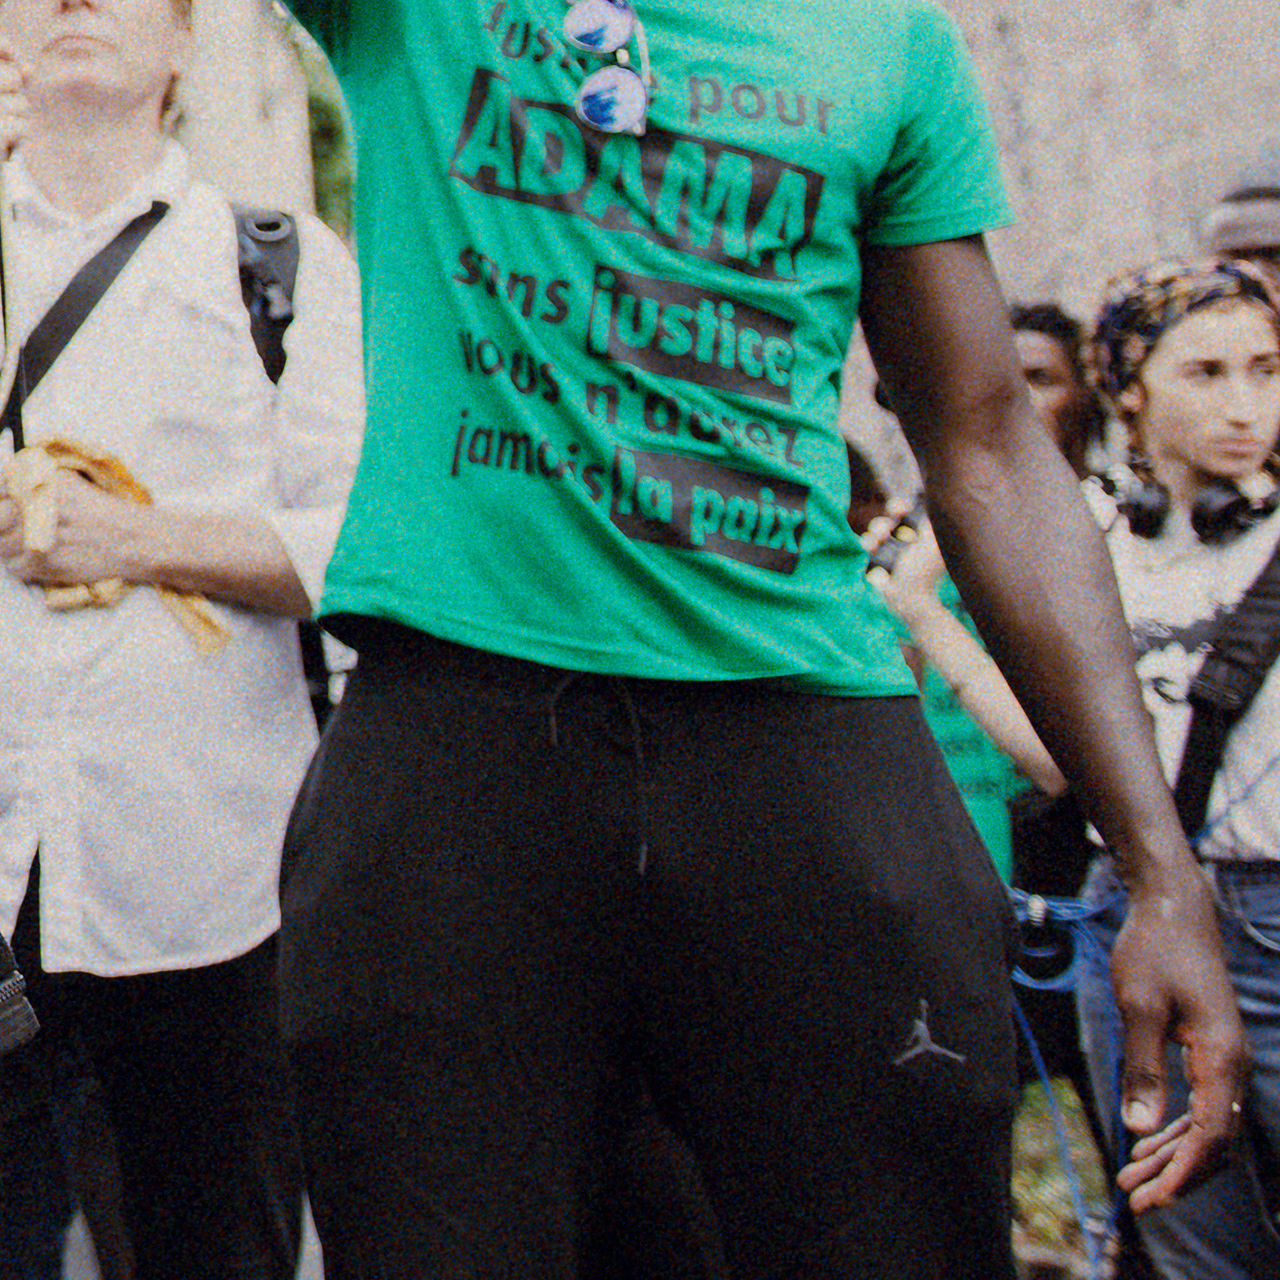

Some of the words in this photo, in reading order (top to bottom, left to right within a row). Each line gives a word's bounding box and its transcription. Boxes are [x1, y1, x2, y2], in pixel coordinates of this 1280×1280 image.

[687, 72, 839, 135] pour
[588, 269, 797, 389] justice
[690, 486, 809, 555] paix
